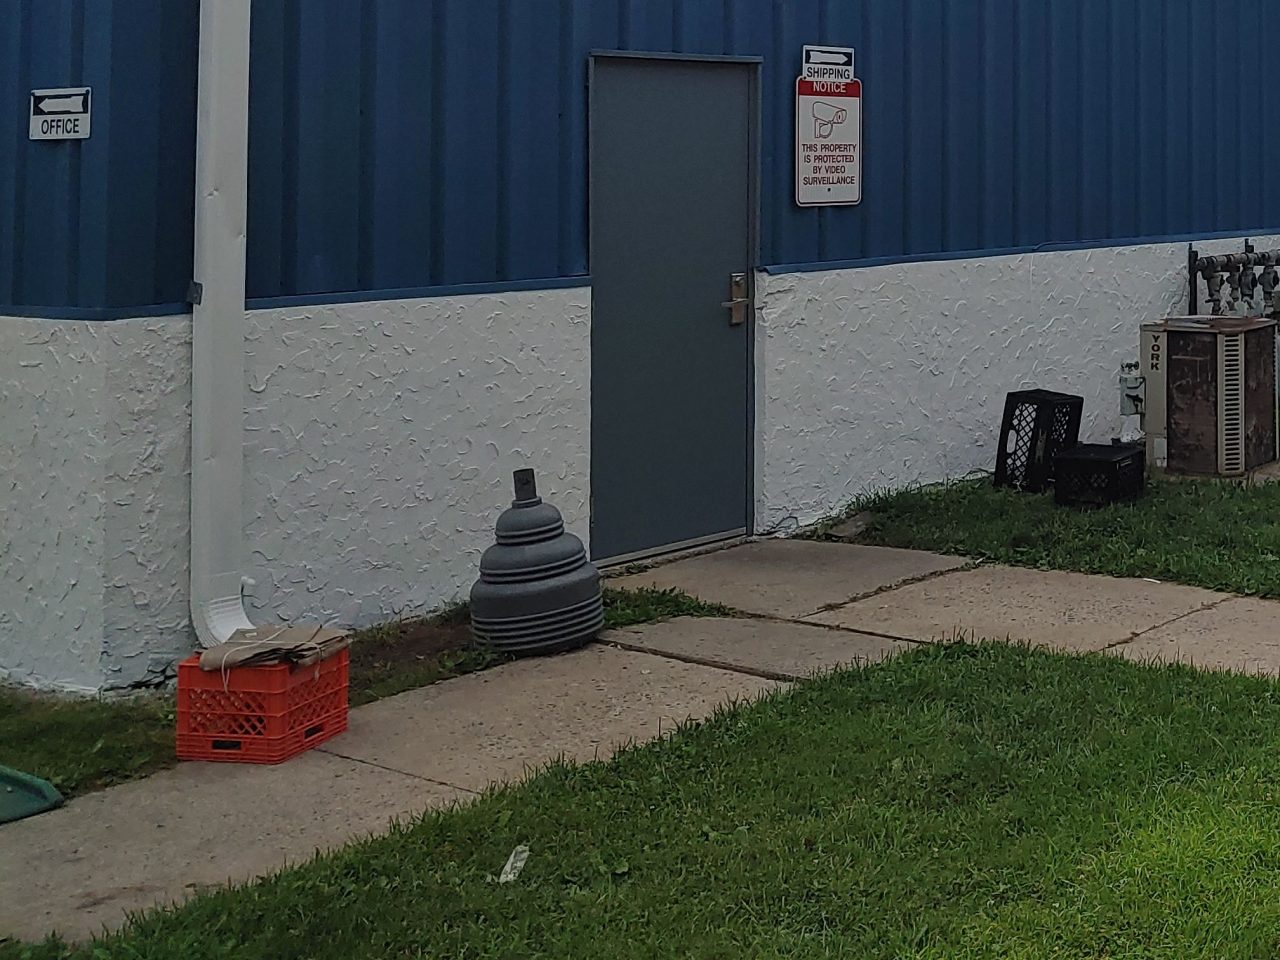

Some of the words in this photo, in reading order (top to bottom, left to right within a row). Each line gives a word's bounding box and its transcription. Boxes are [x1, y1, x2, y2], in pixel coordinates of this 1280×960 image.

[806, 66, 850, 80] SHIPPING
[813, 81, 847, 93] NOTICE
[41, 118, 80, 135] OFFICE
[801, 143, 818, 152] THIS
[820, 143, 857, 153] PROPERTY
[803, 154, 811, 163] IS
[813, 154, 855, 163] PROTECTED
[812, 165, 823, 174] BY
[825, 165, 846, 174] VIDEO
[803, 176, 855, 185] SURVEILLANCE
[1151, 334, 1161, 371] YORK
